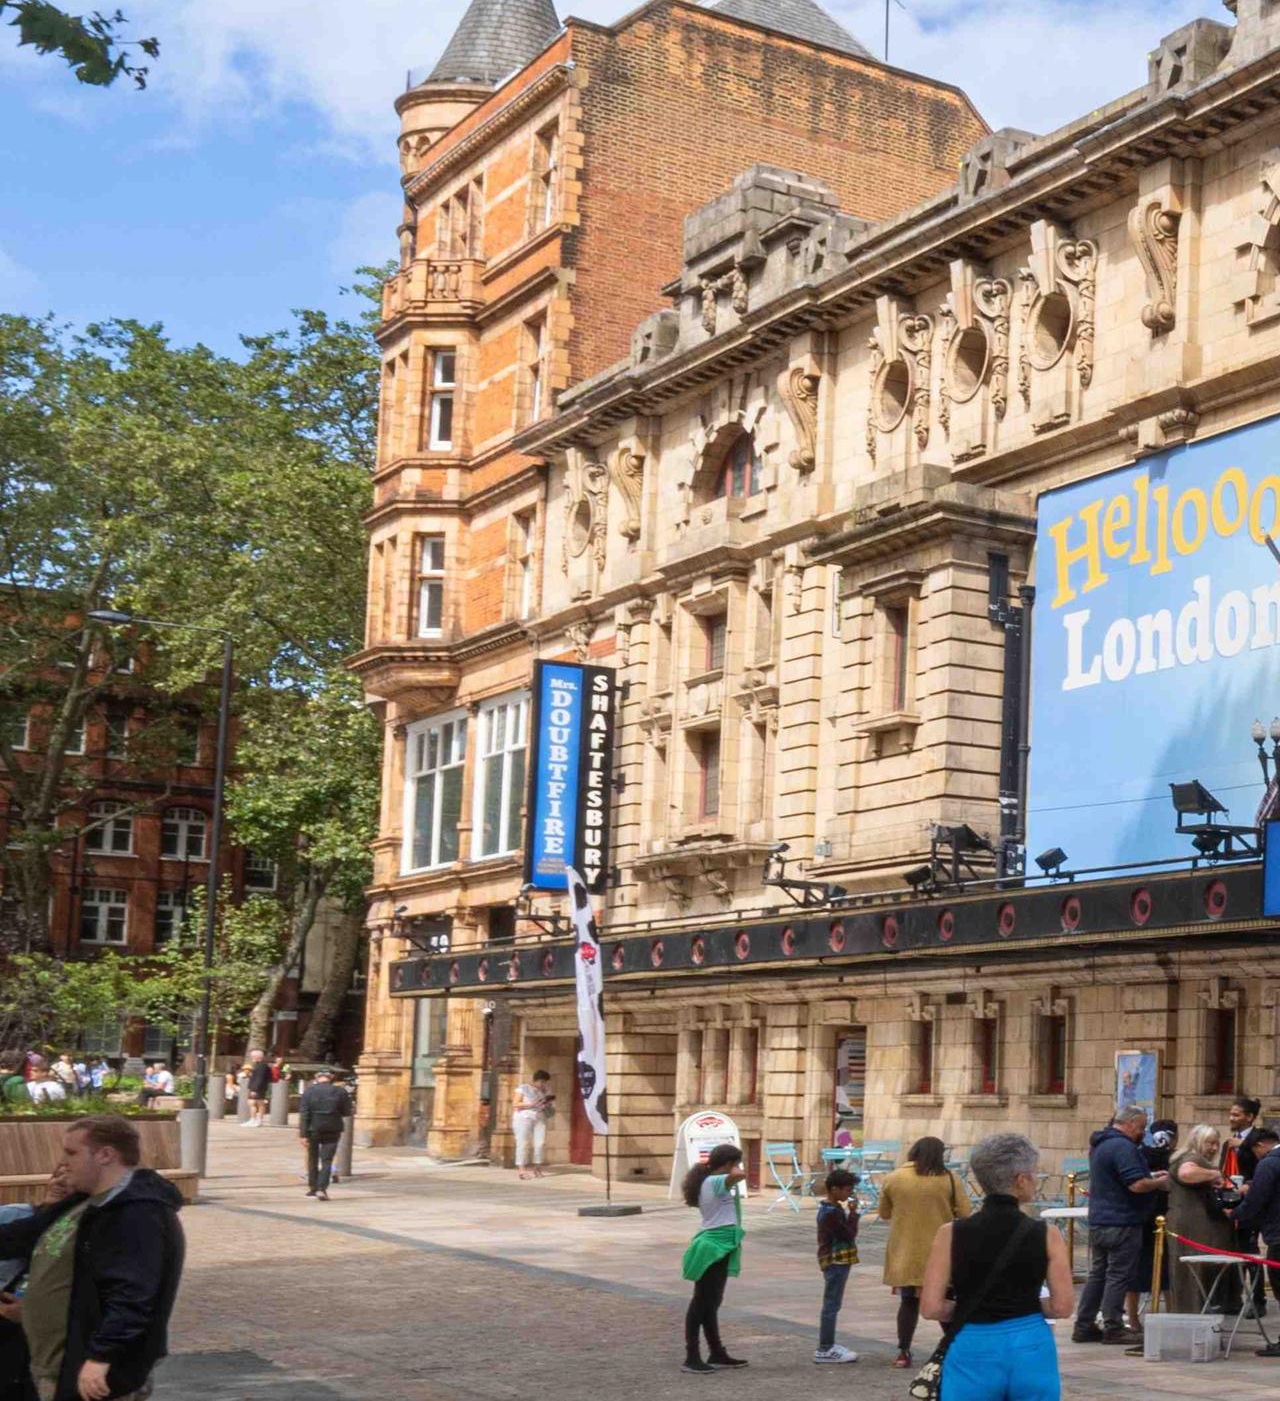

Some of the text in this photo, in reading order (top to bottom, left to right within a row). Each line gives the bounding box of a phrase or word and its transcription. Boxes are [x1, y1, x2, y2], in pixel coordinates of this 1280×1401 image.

[549, 678, 578, 691] Mrs.
[543, 690, 573, 855] DOUBTFIRE
[584, 674, 609, 885] SHAFTESBURY
